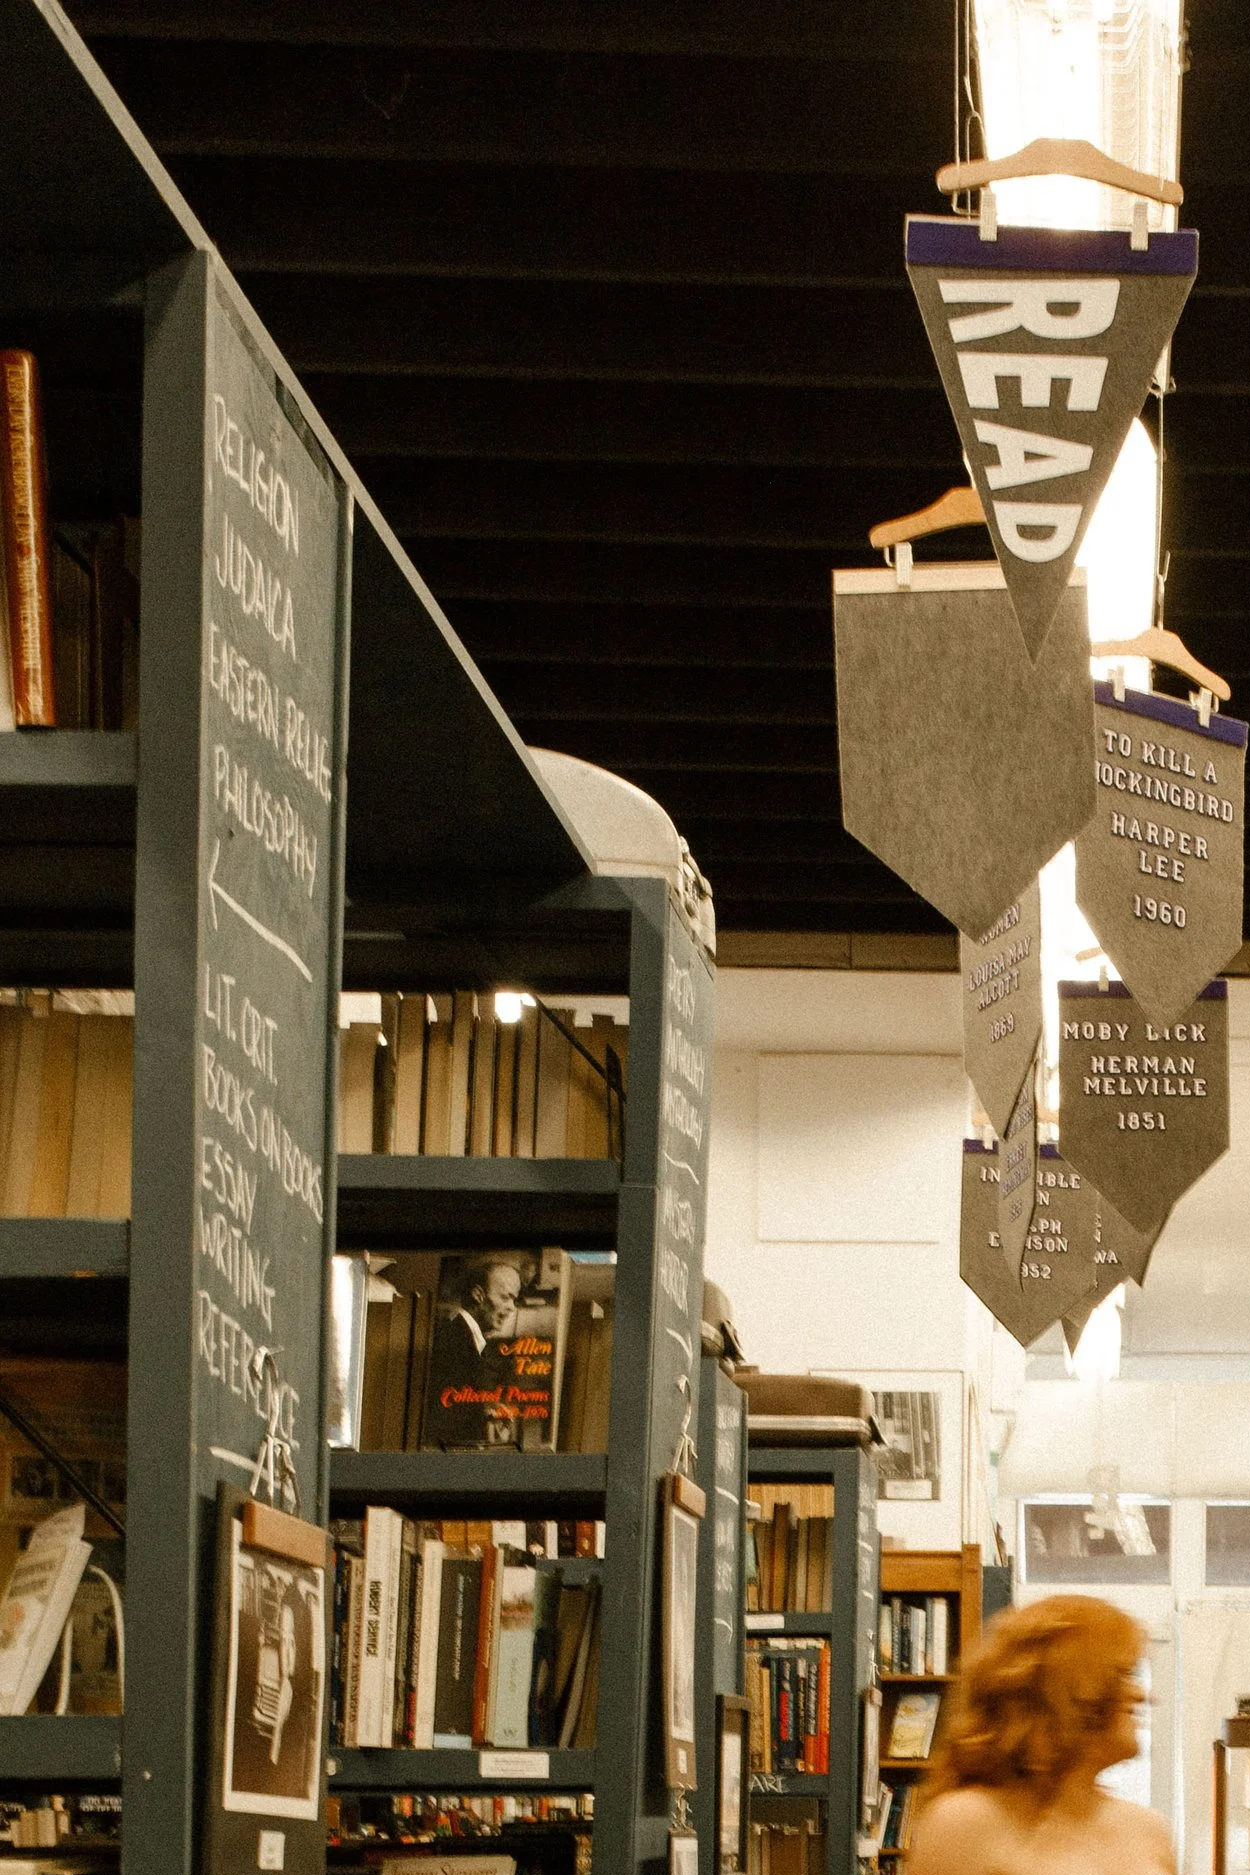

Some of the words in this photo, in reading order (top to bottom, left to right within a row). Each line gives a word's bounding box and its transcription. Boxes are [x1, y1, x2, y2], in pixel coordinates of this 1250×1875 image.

[937, 278, 1120, 563] READ
[213, 393, 299, 558] RELIGION
[215, 514, 296, 663] JUDAICA
[210, 620, 279, 750] EASTERN
[1103, 728, 1132, 757] TO
[1140, 741, 1196, 778] KILL
[1203, 760, 1218, 784] A
[213, 743, 317, 900] PHILOSOPHY
[1111, 811, 1209, 859] HARPER
[1139, 850, 1185, 882] LEE
[1134, 894, 1187, 928] 1960
[968, 952, 1005, 993] LOUISA
[1008, 935, 1031, 968] MAY
[978, 968, 1020, 1011] ALCOTT
[203, 961, 236, 1042] LIT.
[239, 996, 278, 1087] CRIT.
[990, 1012, 1014, 1043] 1869
[1062, 1021, 1129, 1041] MOBY
[1083, 1076, 1207, 1096] MELVILLE
[1091, 1055, 1196, 1075] HERMAN
[201, 1043, 258, 1156] BOOKS
[260, 1104, 281, 1175] ON
[281, 1118, 323, 1225] BOOKS
[1117, 1112, 1166, 1131] 1851
[200, 1135, 258, 1236] ESSAY
[199, 1204, 276, 1333] WRITING
[500, 1337, 552, 1356] Allen
[514, 1356, 552, 1376] Tate
[441, 1385, 503, 1409] Collected
[506, 1385, 550, 1403] Poems
[368, 1581, 382, 1616] ROBERT
